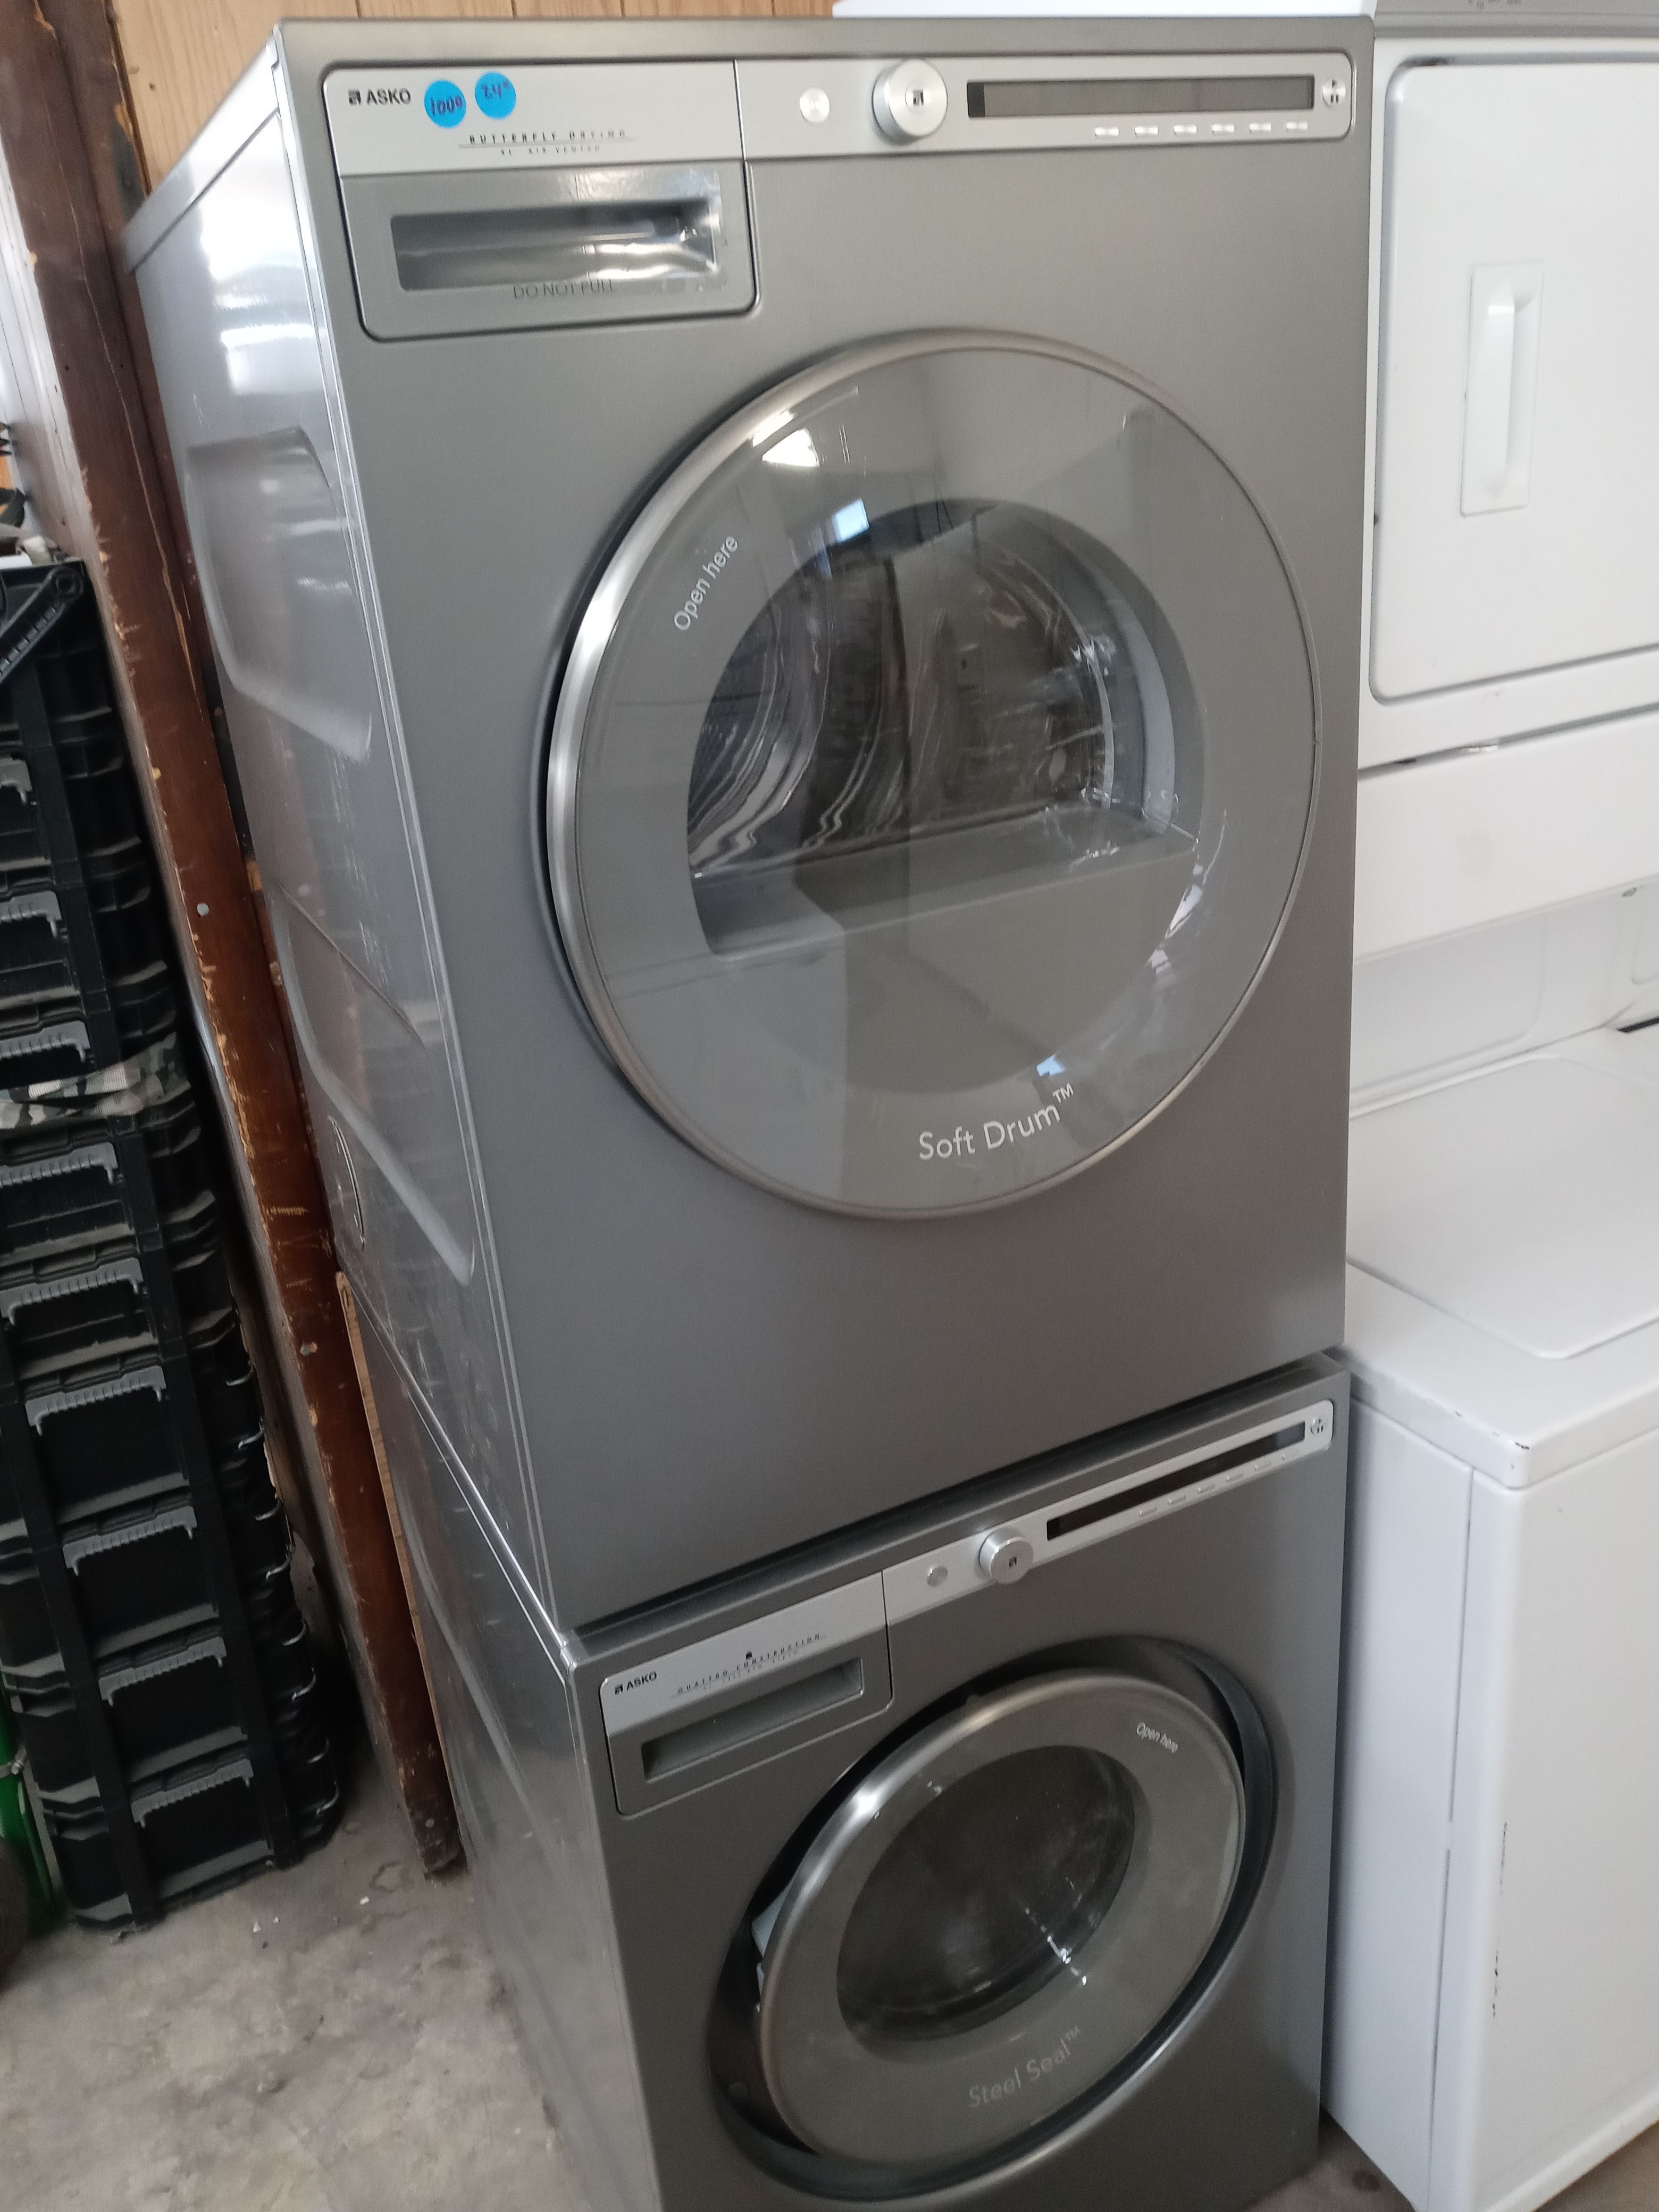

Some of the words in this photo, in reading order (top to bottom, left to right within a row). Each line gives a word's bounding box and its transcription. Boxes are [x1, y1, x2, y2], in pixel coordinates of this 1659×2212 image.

[366, 87, 411, 106] ASKO
[470, 131, 557, 145] BUTTERFLY
[513, 285, 539, 299] DO
[543, 282, 576, 298] NOT
[674, 577, 710, 631] Open
[702, 535, 738, 579] here
[919, 1126, 976, 1160] Soft
[626, 1671, 657, 1691] ASKO
[1136, 1722, 1160, 1742] Open
